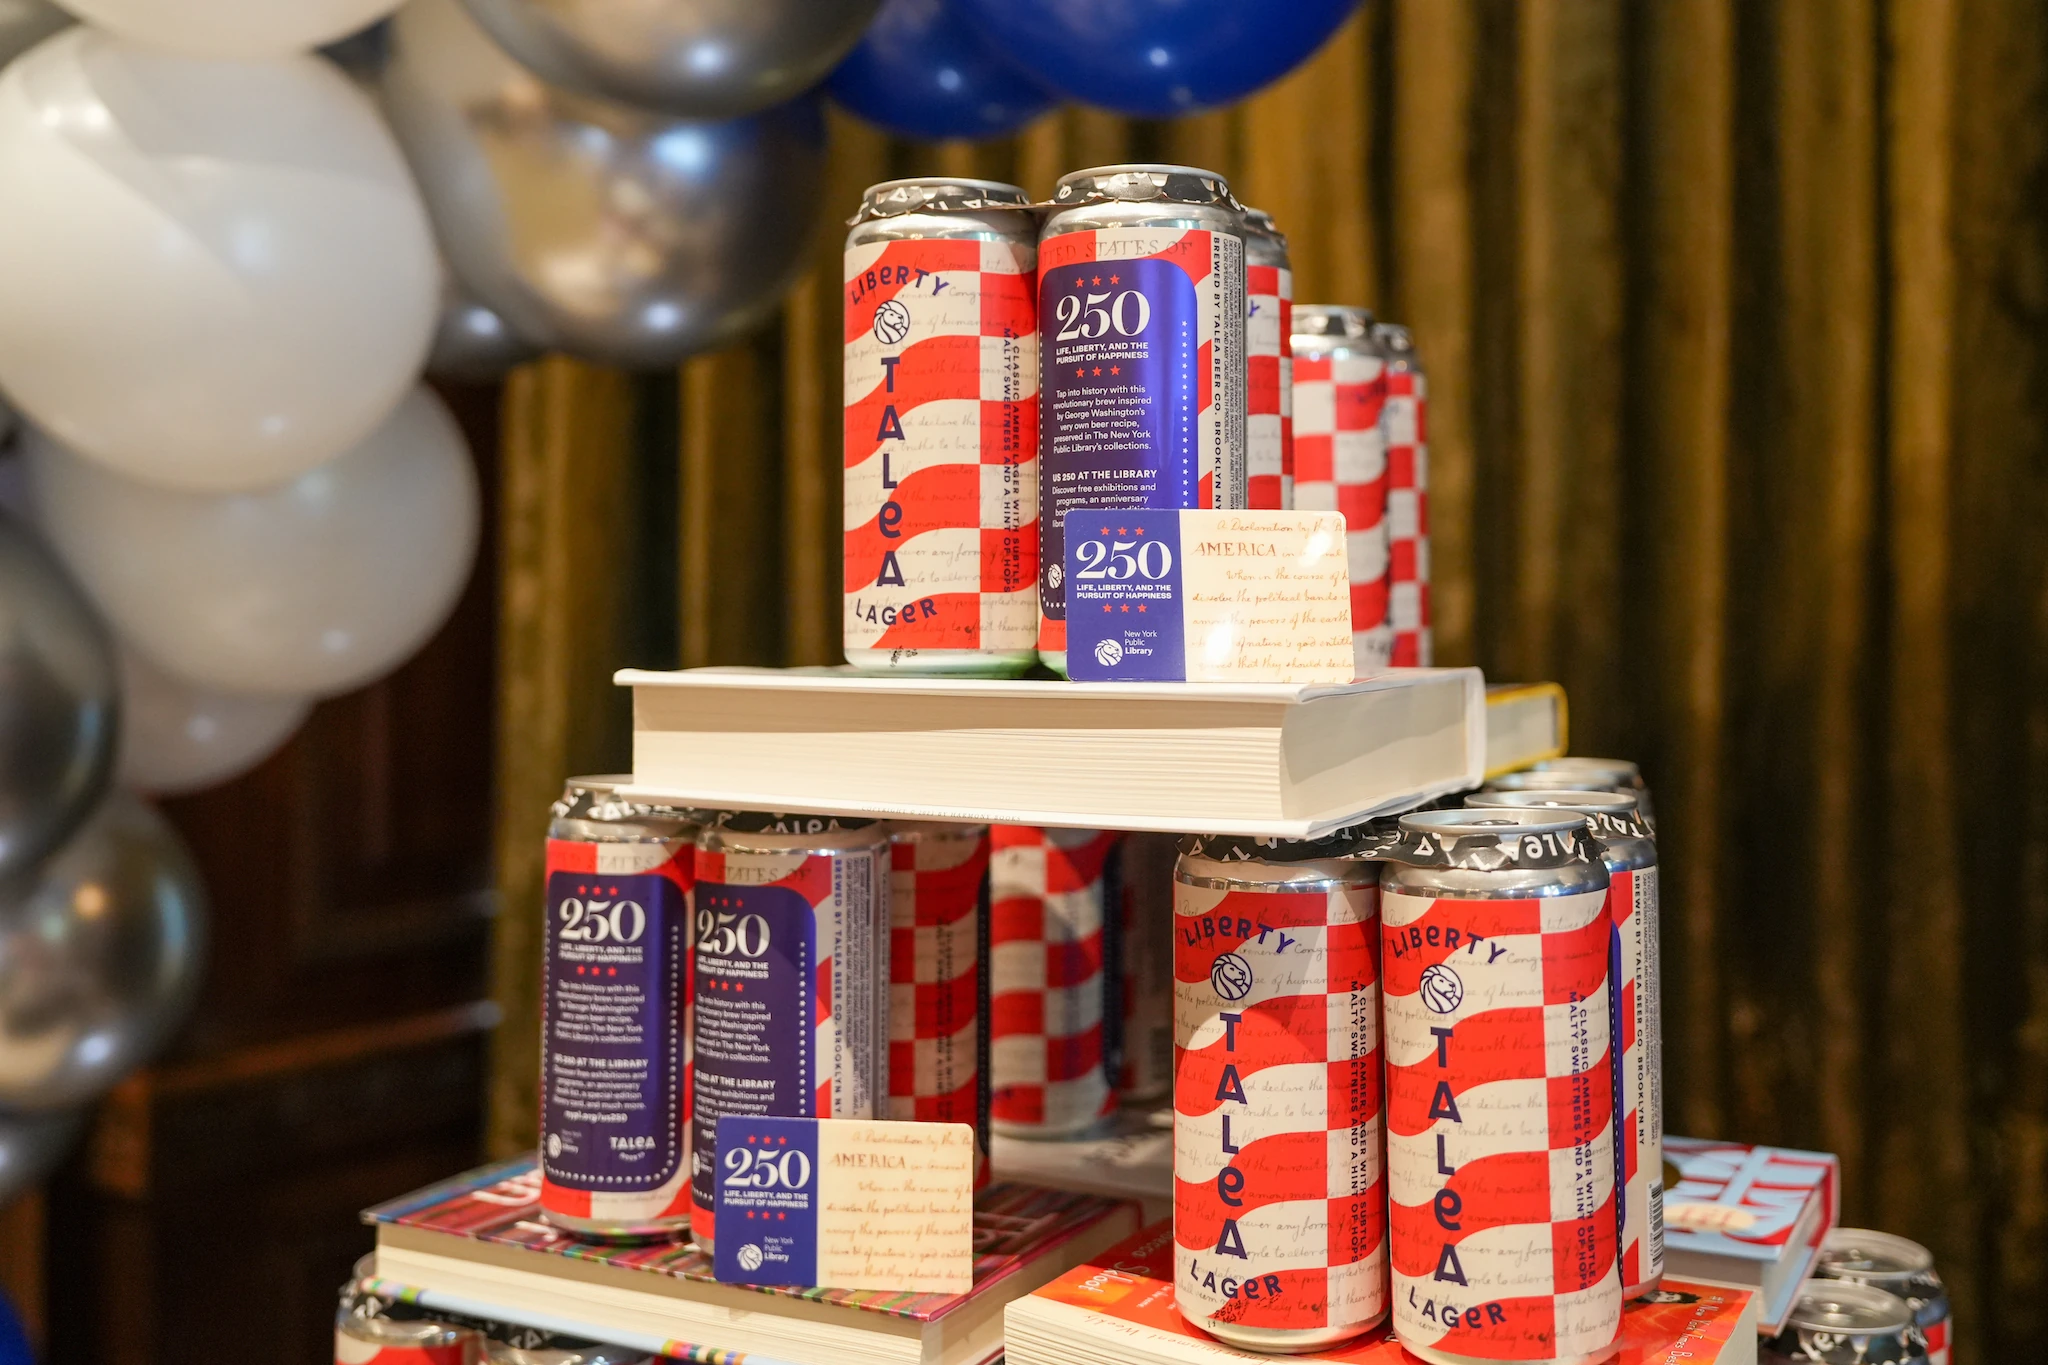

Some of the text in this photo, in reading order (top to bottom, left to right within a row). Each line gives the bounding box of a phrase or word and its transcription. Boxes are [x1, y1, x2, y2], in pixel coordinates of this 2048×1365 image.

[1214, 293, 1221, 309] BY
[1055, 290, 1150, 342] 250
[1013, 332, 1020, 340] A
[1056, 341, 1149, 357] LIFE, LIBERTY, AND THE
[1056, 351, 1149, 364] PURSUIT OF HAPPINESS
[1056, 384, 1146, 399] Tap into history with this
[1052, 396, 1152, 410] revolutionary brew inspired
[1056, 407, 1145, 421] by George Washington's
[1060, 423, 1073, 432] very
[1090, 420, 1110, 429] beer
[1110, 420, 1140, 430] recipe,
[1053, 429, 1151, 444] preserved in The New York
[1053, 445, 1071, 454] Public
[1103, 441, 1152, 451] collections.
[1003, 328, 1011, 593] MALTY SWEETNESS AND A HINT OF HOPS
[1052, 469, 1157, 482] US 250 AT THE LIBRARY
[1052, 482, 1157, 495] Discover free exhibitions and
[1056, 495, 1149, 507] programs, an anniversary
[1214, 494, 1221, 509] NY
[1191, 542, 1277, 557] AMERICA
[1075, 540, 1173, 580] 250
[1076, 584, 1097, 592] LIFE,
[1097, 584, 1134, 592] LIBERTY,
[1124, 630, 1158, 638] New York
[1124, 638, 1145, 646] Public
[1125, 647, 1153, 657] Library
[559, 897, 646, 943] 250
[697, 909, 771, 958] 250
[1359, 983, 1367, 992] A
[1580, 994, 1587, 1003] A
[1359, 997, 1367, 1056] CLASSIC
[1580, 1009, 1589, 1070] CLASSIC
[1359, 1061, 1367, 1107] AMBER
[1583, 1077, 1591, 1125] AMBER
[1351, 981, 1359, 1263] MALTY SWEETNESS AND A HINT OF HOPS
[1359, 1112, 1367, 1155] LAGER
[1570, 992, 1588, 1291] MALTY SWEETNESS AND A HINT OF HOPS
[830, 1153, 906, 1169] AMERICA
[1584, 1131, 1593, 1176] LAGER
[723, 1147, 811, 1191] 250
[1359, 1160, 1367, 1196] WITH
[723, 1197, 809, 1209] PURSUIT OF HAPPINESS
[775, 1191, 792, 1200] AND
[793, 1192, 809, 1201] THE
[1586, 1181, 1594, 1219] WITH
[764, 1235, 794, 1245] New York
[764, 1244, 783, 1252] Public
[764, 1252, 790, 1264] Library
